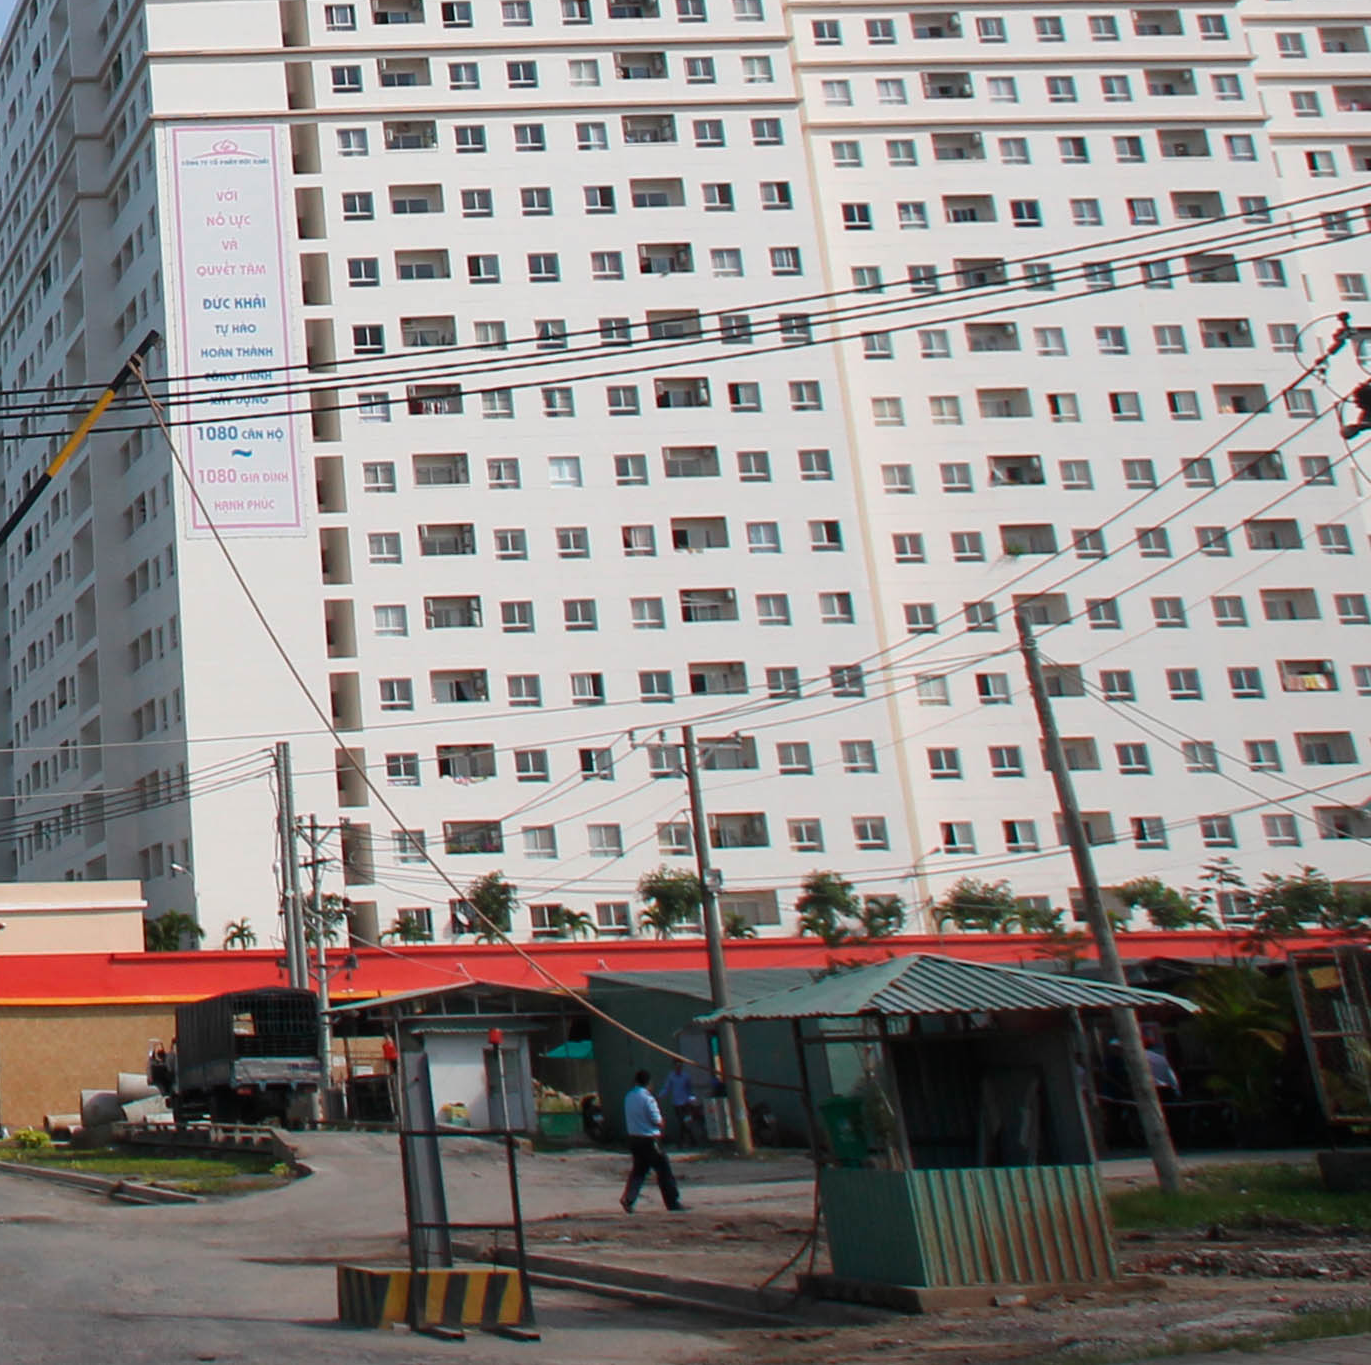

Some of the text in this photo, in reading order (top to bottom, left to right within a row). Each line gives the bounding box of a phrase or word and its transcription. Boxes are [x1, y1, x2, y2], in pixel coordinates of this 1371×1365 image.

[203, 294, 230, 310] ĐỨC
[197, 426, 238, 440] 1080
[198, 468, 237, 483] 1080
